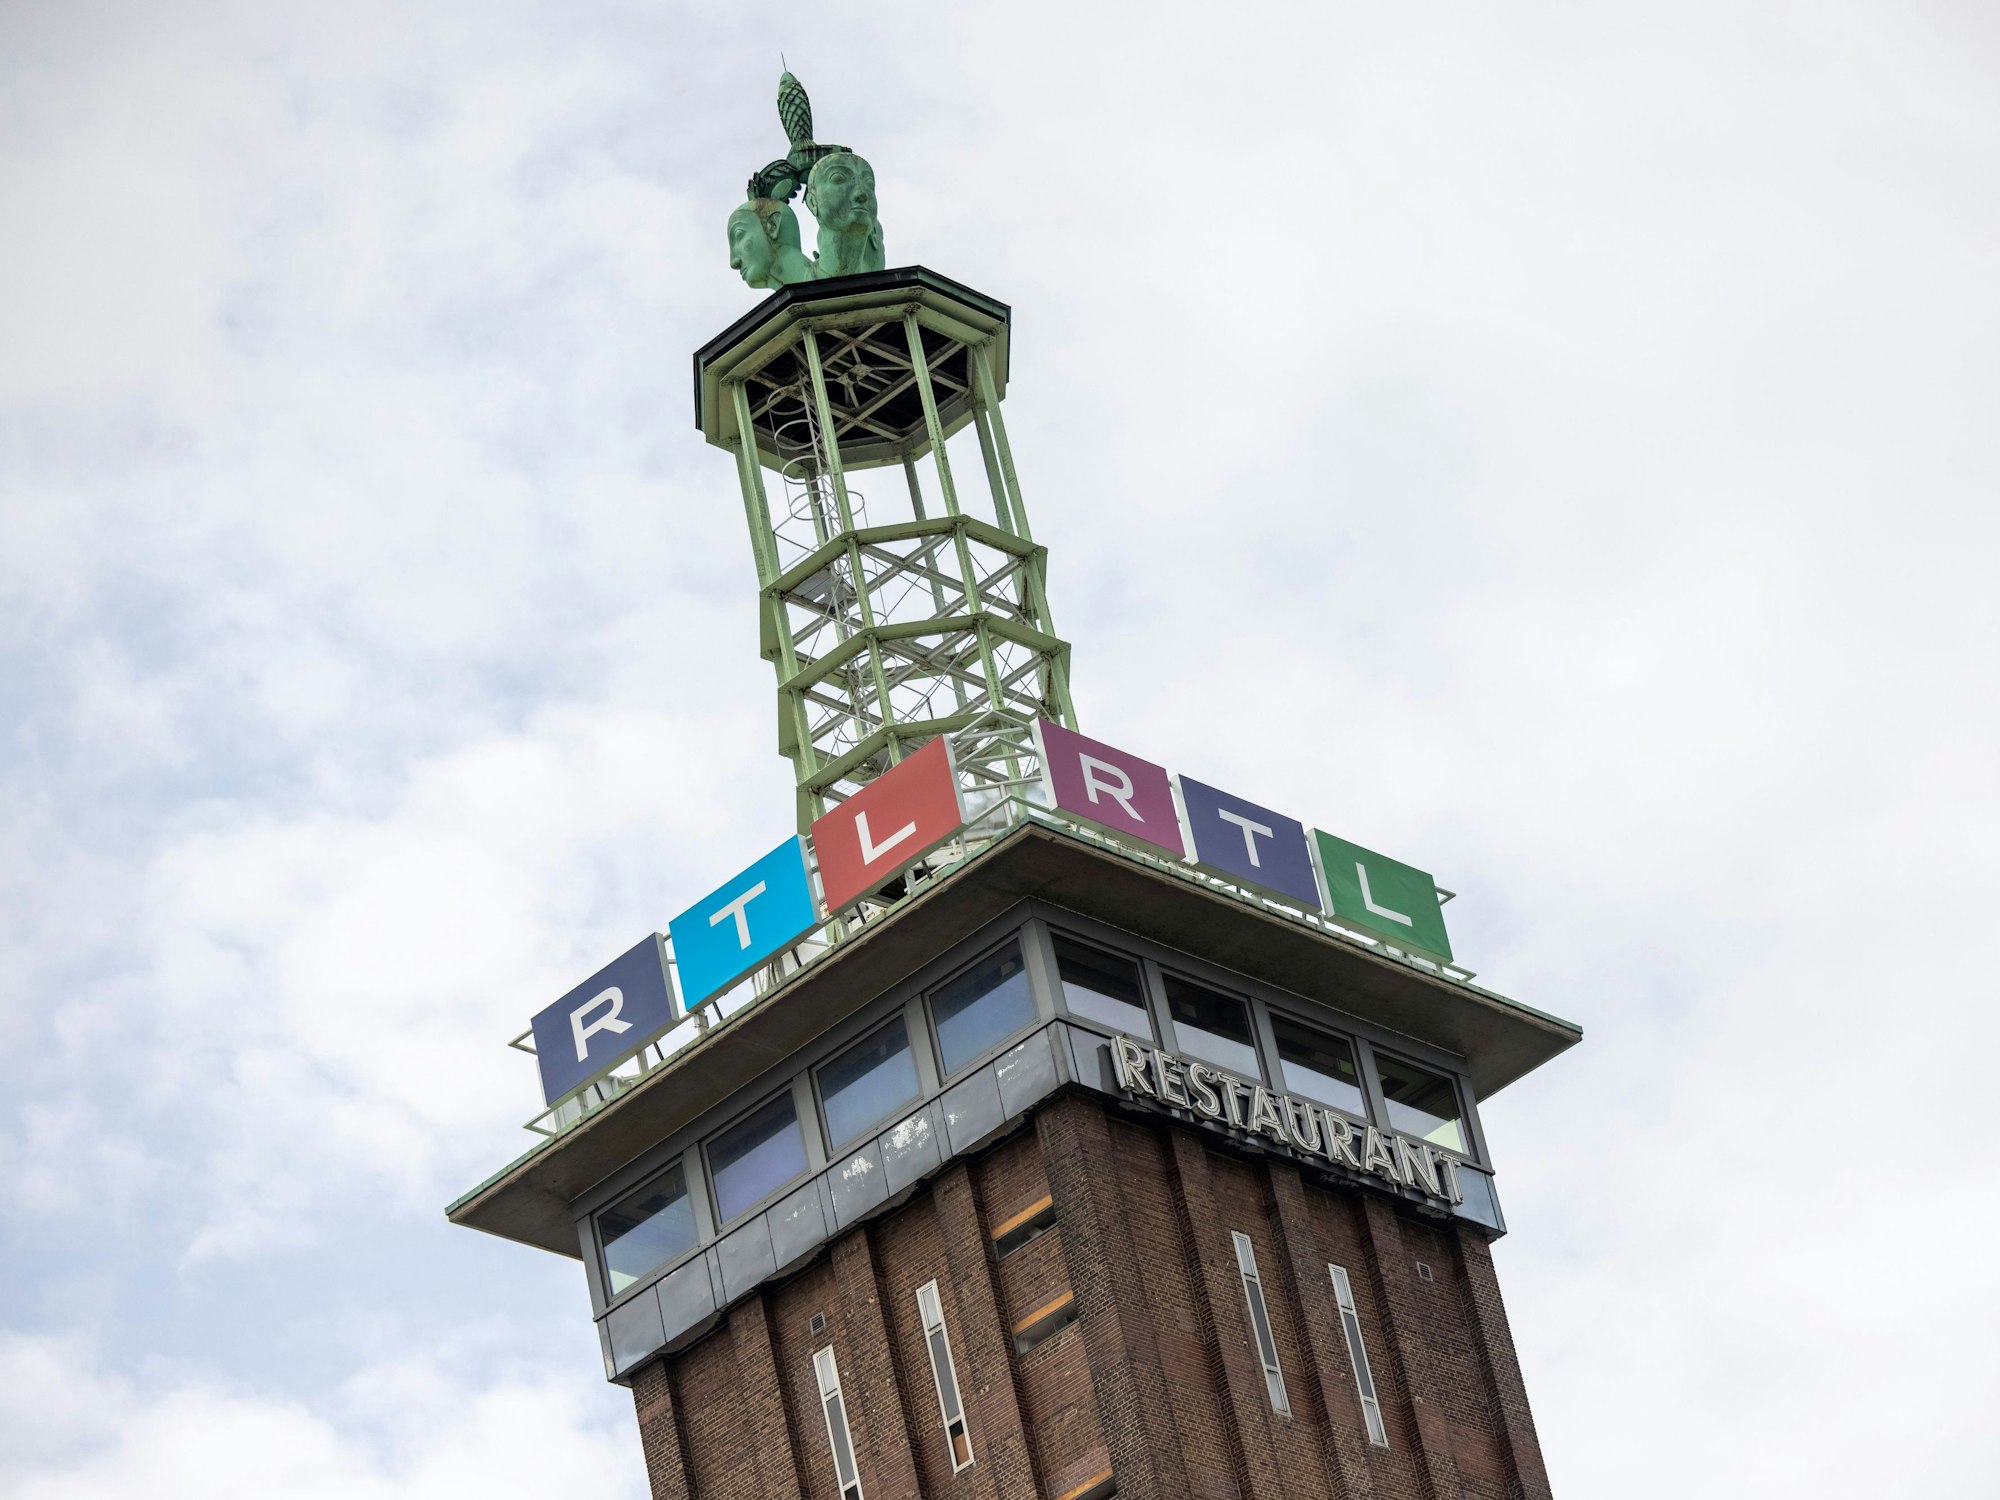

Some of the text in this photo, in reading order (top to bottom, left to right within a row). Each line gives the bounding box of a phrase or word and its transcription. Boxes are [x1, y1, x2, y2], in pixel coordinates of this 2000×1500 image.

[1078, 752, 1413, 927] RTL
[569, 810, 917, 1063] RTL
[1110, 1035, 1464, 1206] RESTAURANT
